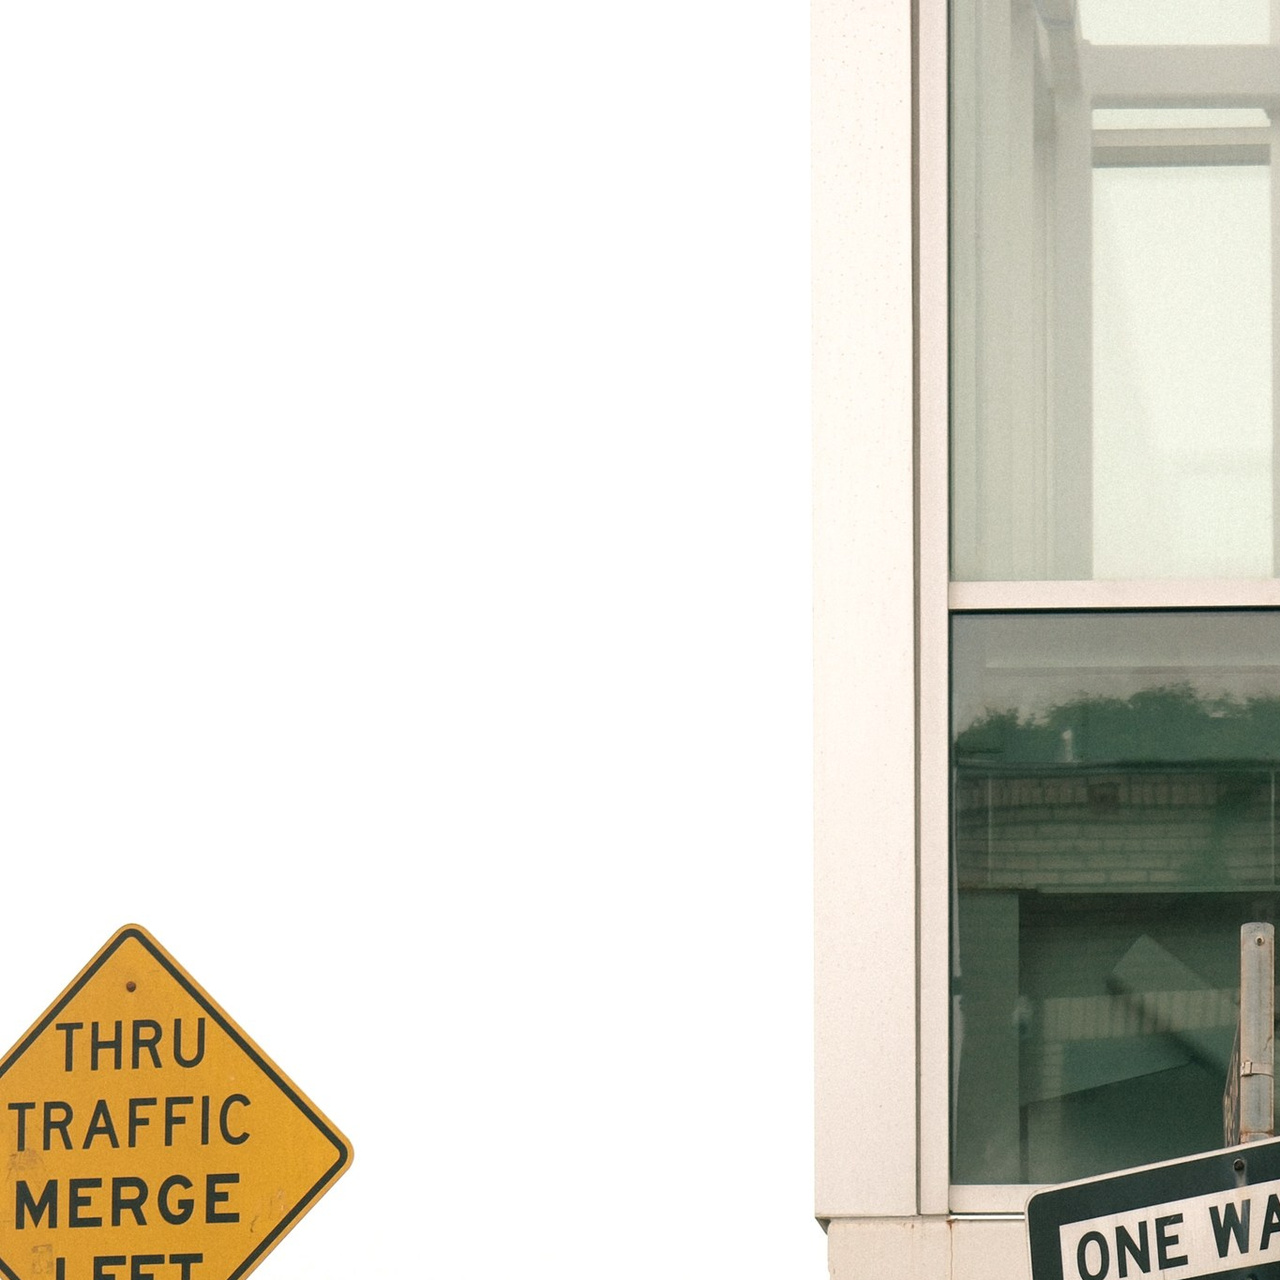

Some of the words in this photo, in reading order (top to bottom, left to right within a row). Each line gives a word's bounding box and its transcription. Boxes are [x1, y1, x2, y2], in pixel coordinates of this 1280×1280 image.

[55, 1017, 206, 1072] THRU
[8, 1093, 252, 1152] TRAFFIC
[15, 1172, 240, 1230] MERGE
